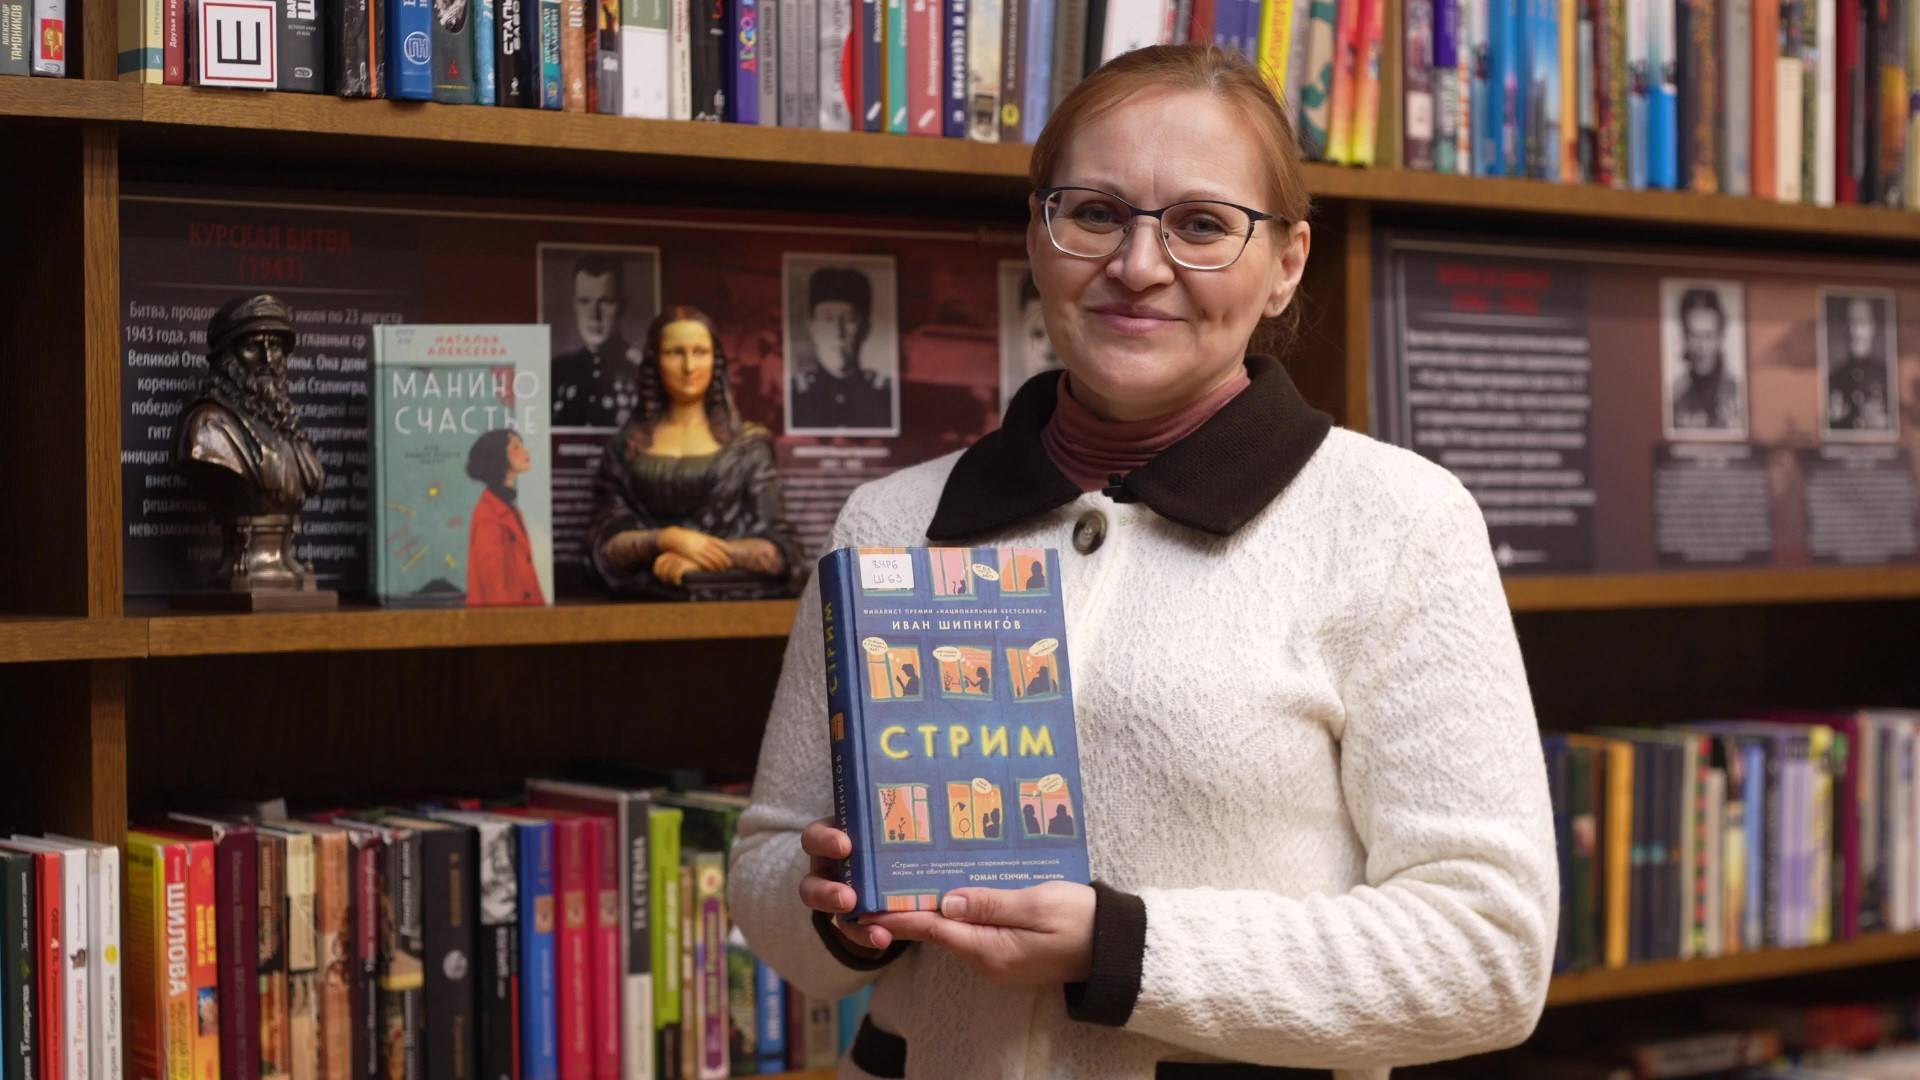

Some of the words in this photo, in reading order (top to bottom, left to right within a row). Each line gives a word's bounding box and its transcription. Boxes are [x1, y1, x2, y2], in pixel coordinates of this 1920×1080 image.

[10, 4, 22, 61] ТАМОНИКОВ
[216, 19, 262, 65] Ш
[188, 222, 280, 250] КУРСКАЯ
[285, 225, 353, 253] БИТВА
[239, 255, 304, 285] (1943)
[129, 300, 169, 321] Битва,
[126, 325, 153, 343] 1943
[156, 329, 187, 347] года,
[128, 350, 179, 368] Великой
[137, 376, 196, 395] коренной
[392, 370, 540, 400] МАНИНО
[395, 404, 537, 435] СЧАСТЬЕ
[892, 619, 931, 631] ИВАН
[904, 607, 933, 616] ПРЕМИИ
[880, 724, 1056, 759] СТРИМ
[969, 872, 997, 881] РОМАН
[999, 871, 1032, 881] СЕНЧИН,
[167, 881, 190, 997] ШИЛОВА
